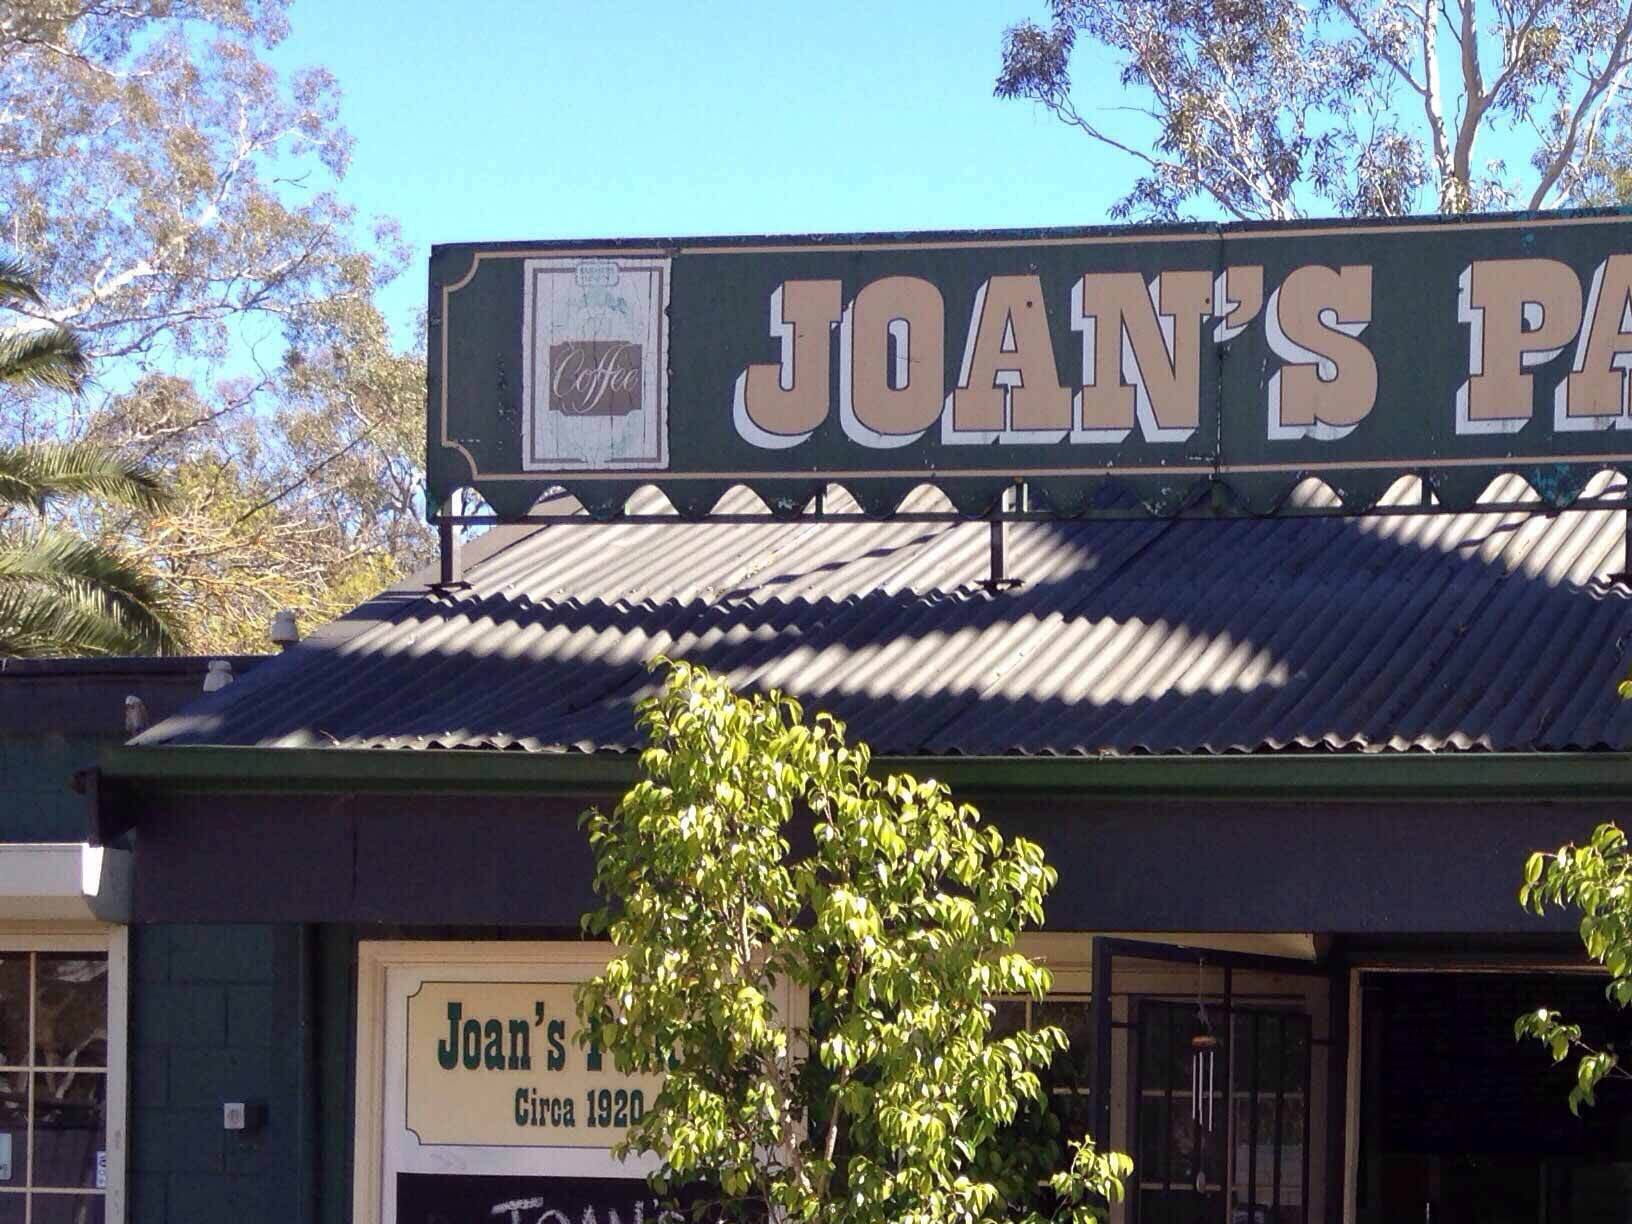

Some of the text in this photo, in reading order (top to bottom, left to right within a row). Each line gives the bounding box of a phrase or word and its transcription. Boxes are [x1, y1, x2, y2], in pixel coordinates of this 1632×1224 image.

[552, 343, 640, 414] Coffee
[734, 264, 1379, 449] JOAN'S
[437, 1002, 566, 1071] Joan's
[515, 1087, 645, 1128] Circa 1920
